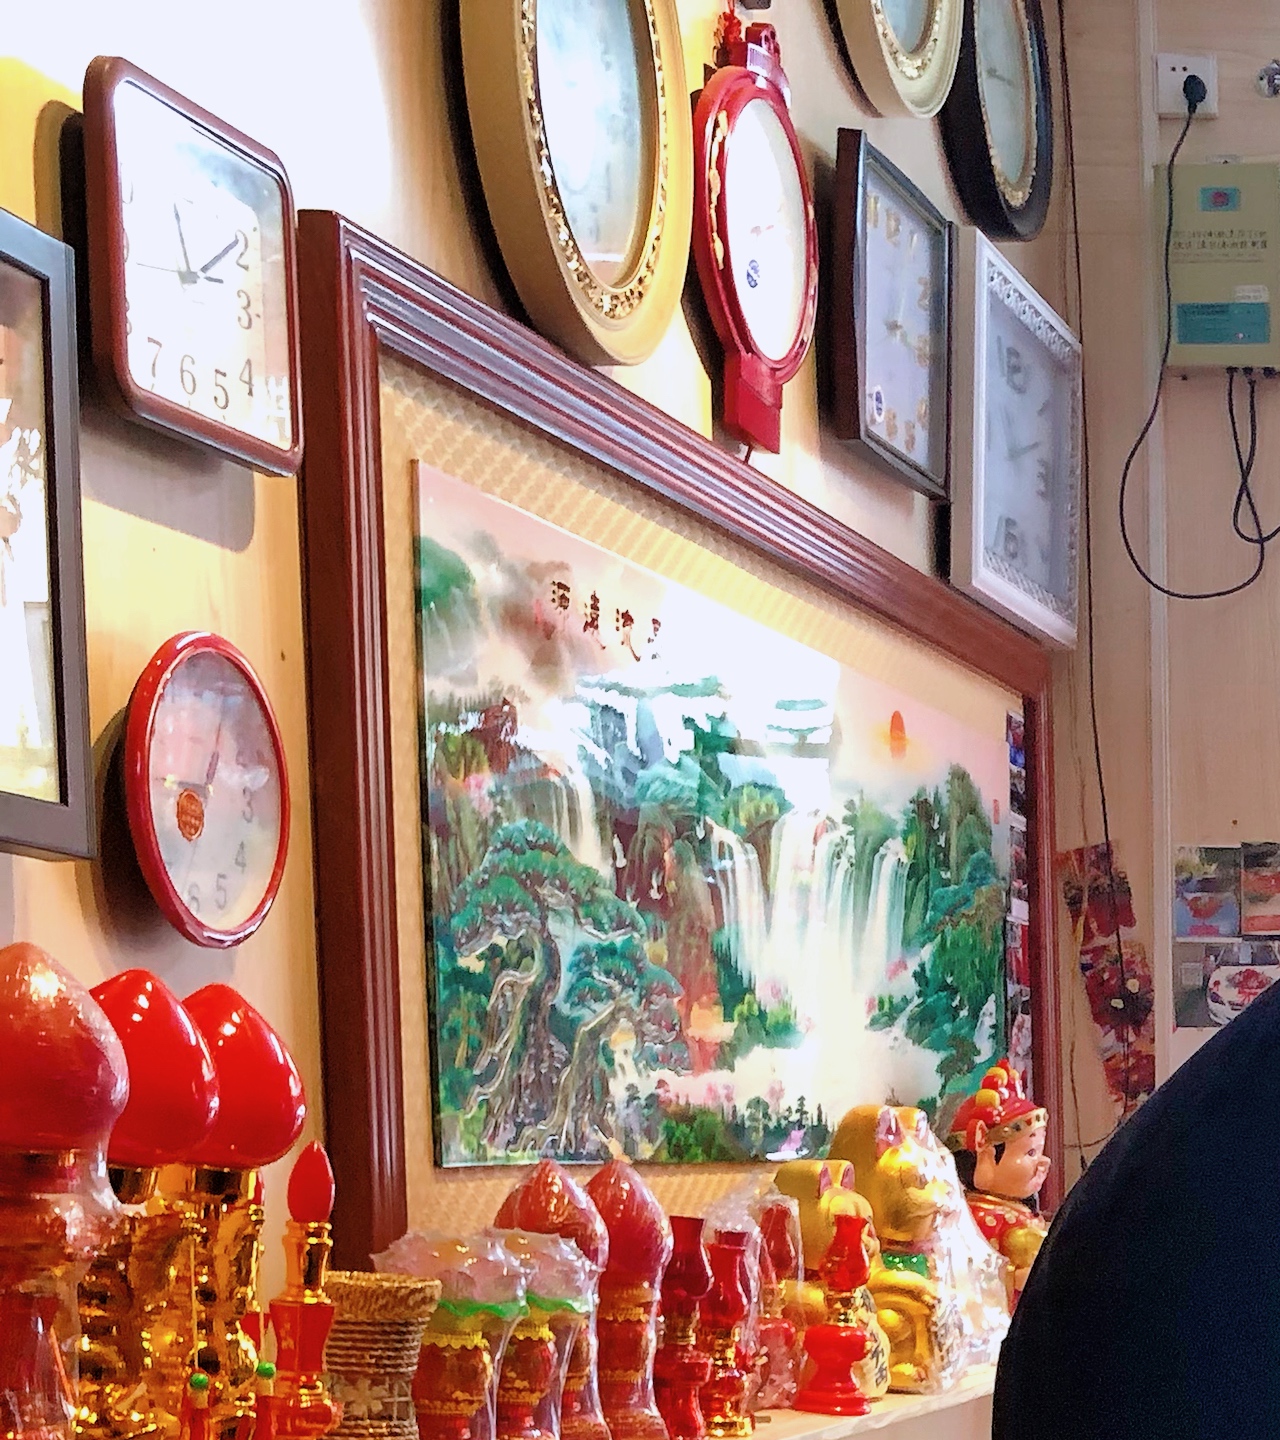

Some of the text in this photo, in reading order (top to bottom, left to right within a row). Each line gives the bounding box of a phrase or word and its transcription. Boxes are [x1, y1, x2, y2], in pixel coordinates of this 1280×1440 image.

[237, 288, 254, 330] 3
[147, 336, 163, 378] 7
[180, 354, 197, 396] 6
[239, 358, 254, 398] 4
[213, 368, 229, 411] 5
